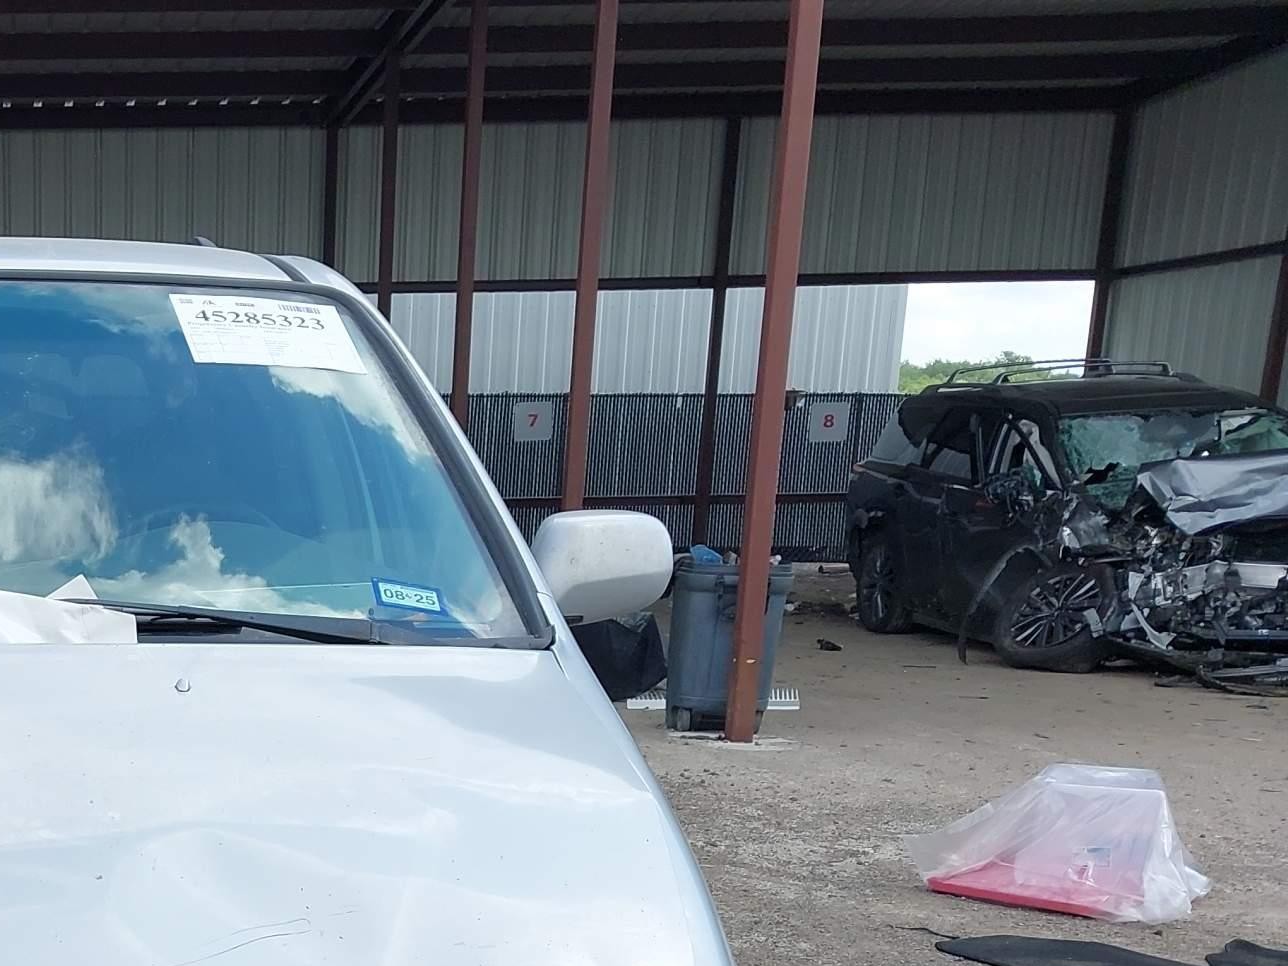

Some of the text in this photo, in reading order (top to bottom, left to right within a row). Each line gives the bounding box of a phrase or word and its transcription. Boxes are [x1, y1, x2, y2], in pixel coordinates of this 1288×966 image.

[195, 309, 325, 330] 45285323
[527, 413, 538, 427] 7
[823, 414, 834, 428] 8
[383, 588, 406, 601] 08
[414, 593, 436, 606] 25
